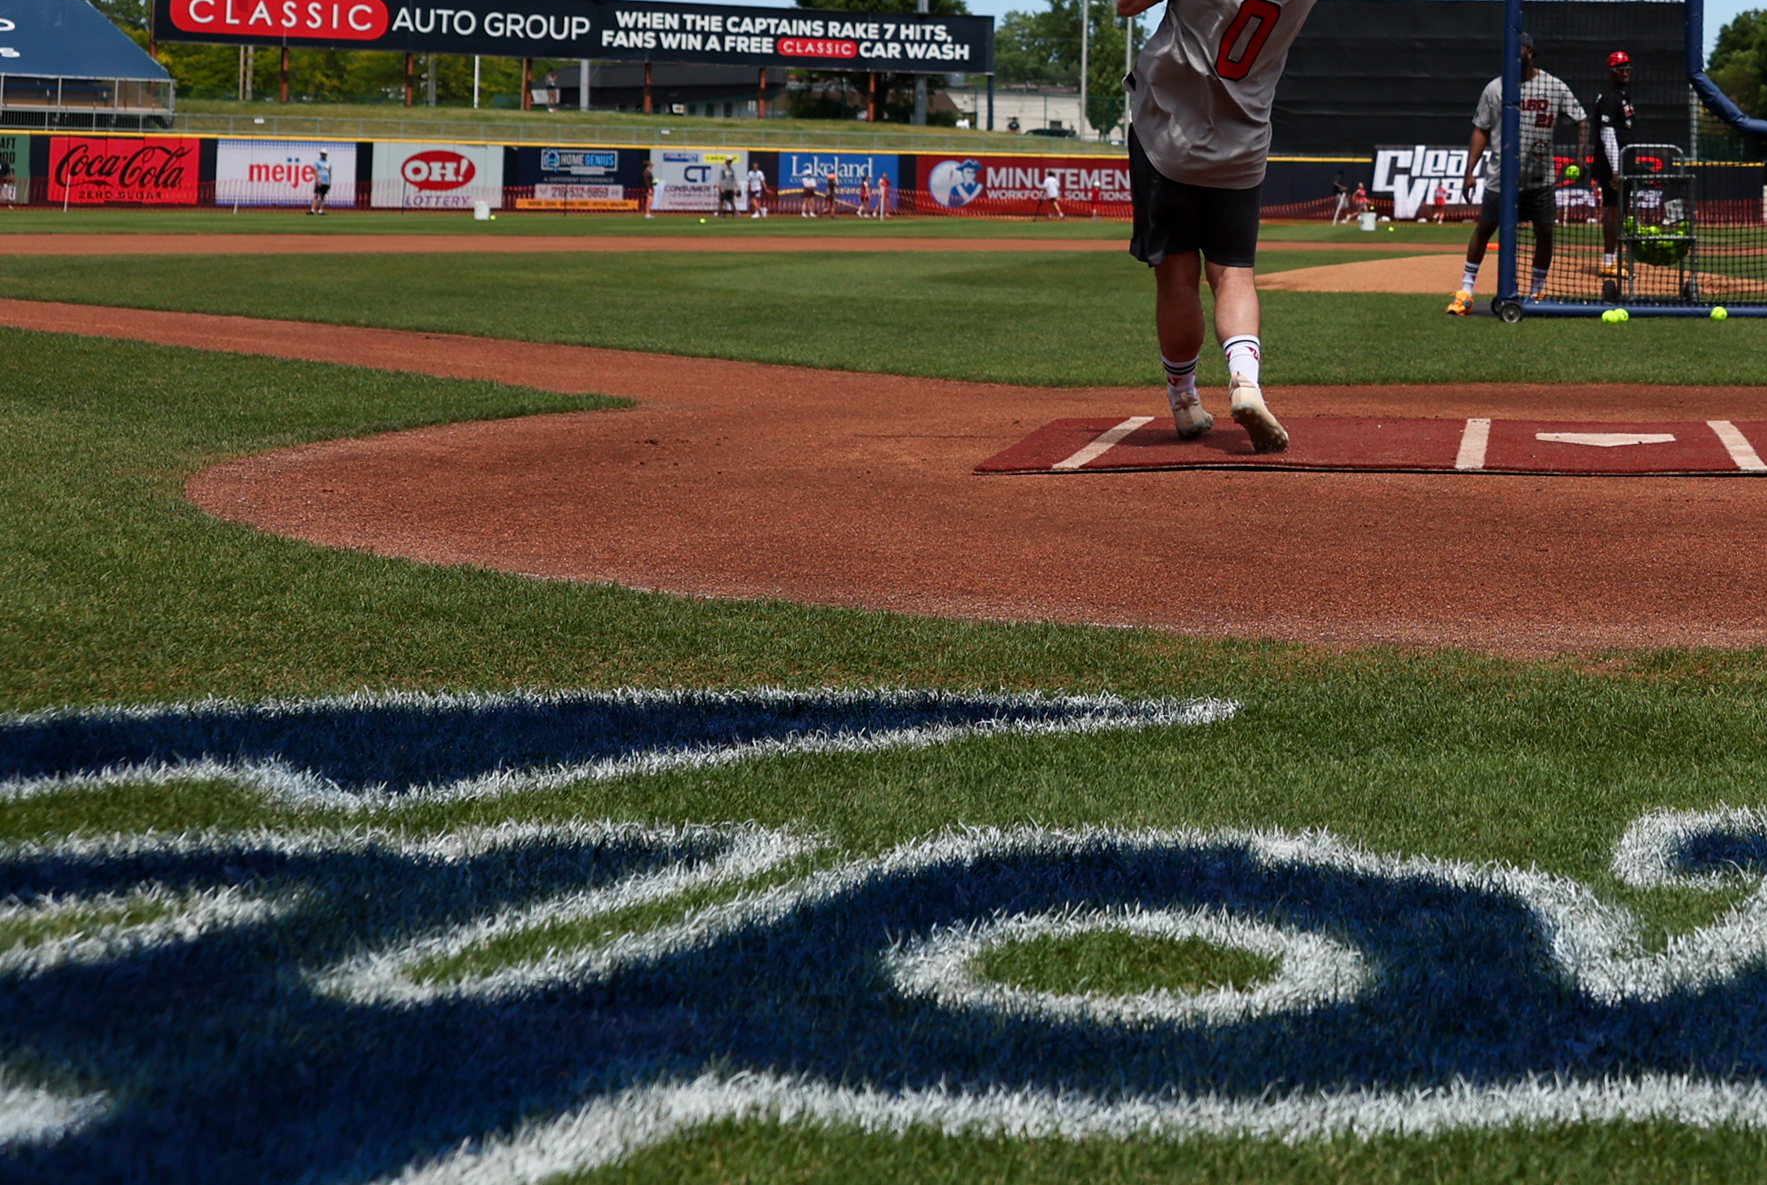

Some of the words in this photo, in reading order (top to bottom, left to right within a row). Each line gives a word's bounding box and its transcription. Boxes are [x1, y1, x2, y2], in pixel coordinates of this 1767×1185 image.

[392, 7, 477, 35] AUTO
[484, 12, 590, 41] GROUP
[615, 11, 680, 30] WHEN
[683, 14, 722, 32] THE
[726, 16, 824, 38] CAPTAINS
[827, 21, 879, 39] RAKE
[883, 23, 893, 40] 7
[900, 24, 952, 43] HITS,
[601, 30, 656, 49] FANS
[660, 32, 702, 51] WIN
[705, 34, 722, 52] A
[724, 35, 774, 54] FREE
[783, 40, 853, 56] CLASSIC
[859, 41, 901, 59] CAR
[904, 42, 970, 60] WASH
[55, 144, 193, 188] Coca-Cola
[248, 158, 315, 189] meije
[404, 157, 469, 183] OH!
[561, 154, 584, 166] HOME
[585, 154, 615, 166] GENIUS
[791, 156, 873, 177] Lakeland
[78, 190, 113, 199] ZERO
[117, 190, 162, 200] SUGAR
[405, 196, 471, 206] LOTTERY
